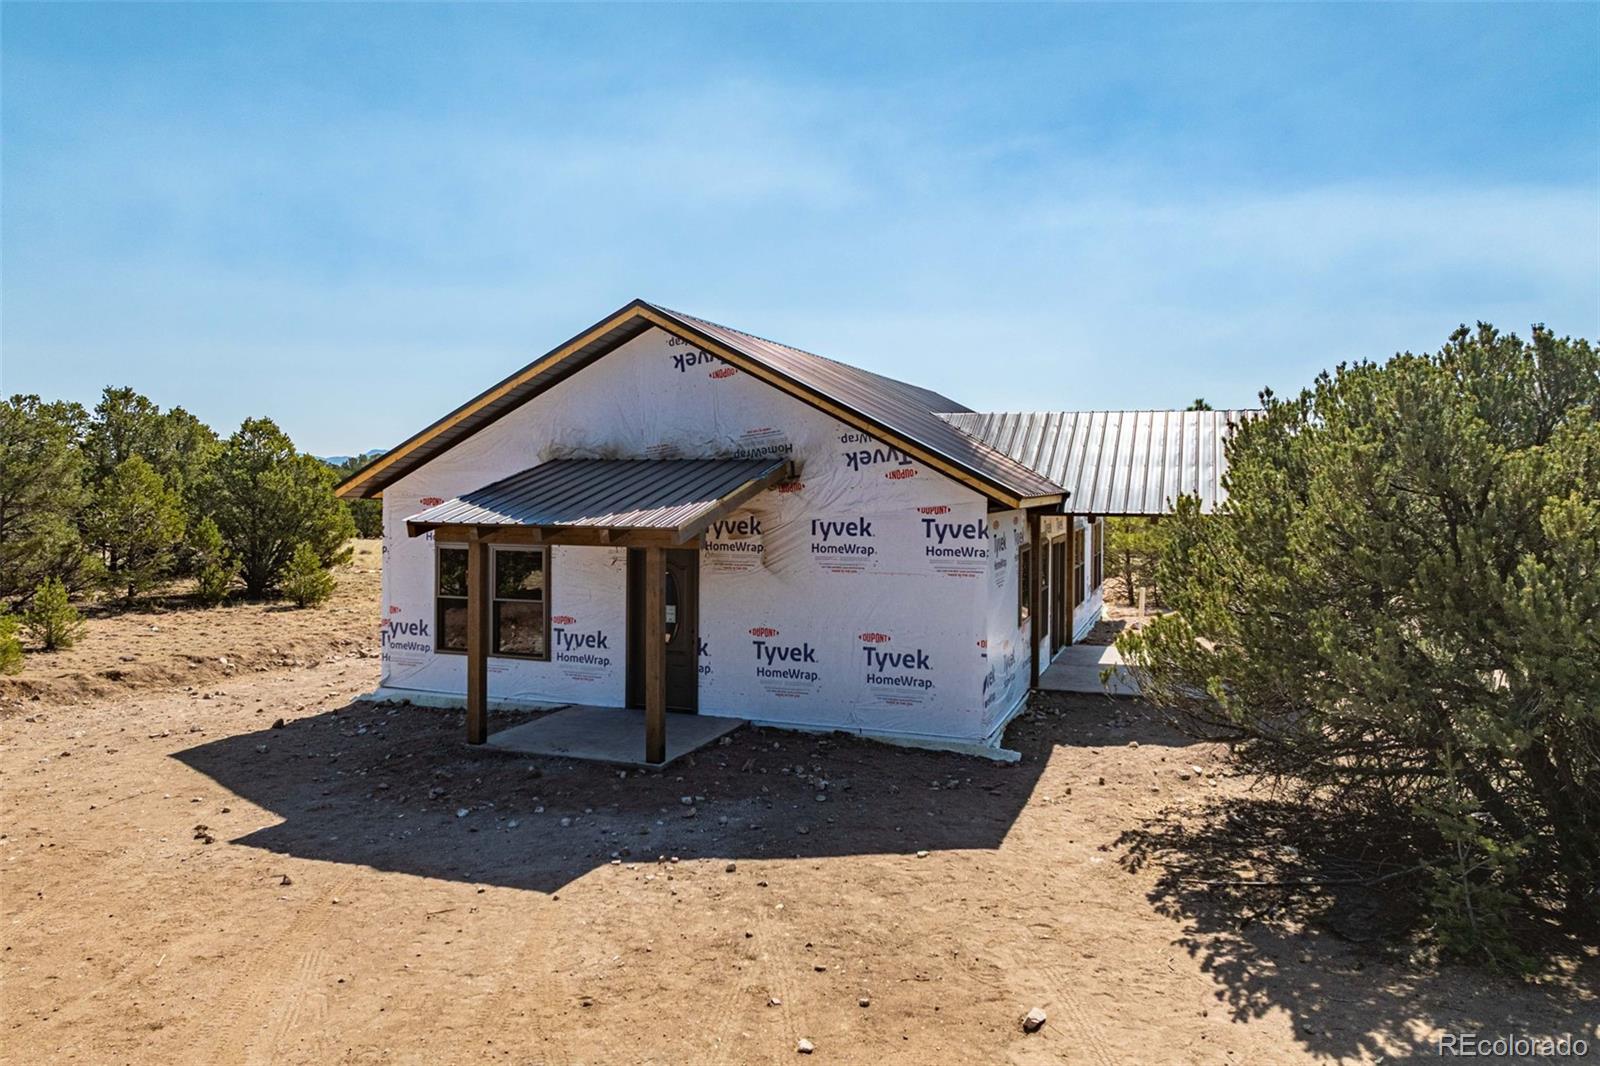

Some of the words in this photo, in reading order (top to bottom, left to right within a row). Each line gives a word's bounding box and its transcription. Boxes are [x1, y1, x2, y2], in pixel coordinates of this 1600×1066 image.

[888, 469, 914, 480] DUPONT
[705, 516, 762, 540] yvek
[921, 518, 989, 544] Tyvek
[811, 543, 875, 557] HomeWrap
[926, 545, 988, 559] HomeWra
[390, 618, 429, 639] yvek
[752, 627, 777, 638] DUPONT
[553, 627, 608, 651] Tyvek
[862, 633, 888, 642] DUPONT
[390, 641, 431, 654] omeWrap
[752, 640, 815, 665] Tyvek
[556, 652, 611, 666] HomeWrap
[862, 646, 930, 672] Tyvek
[756, 667, 818, 682] HomeWrap
[866, 673, 933, 689] HomeWrap
